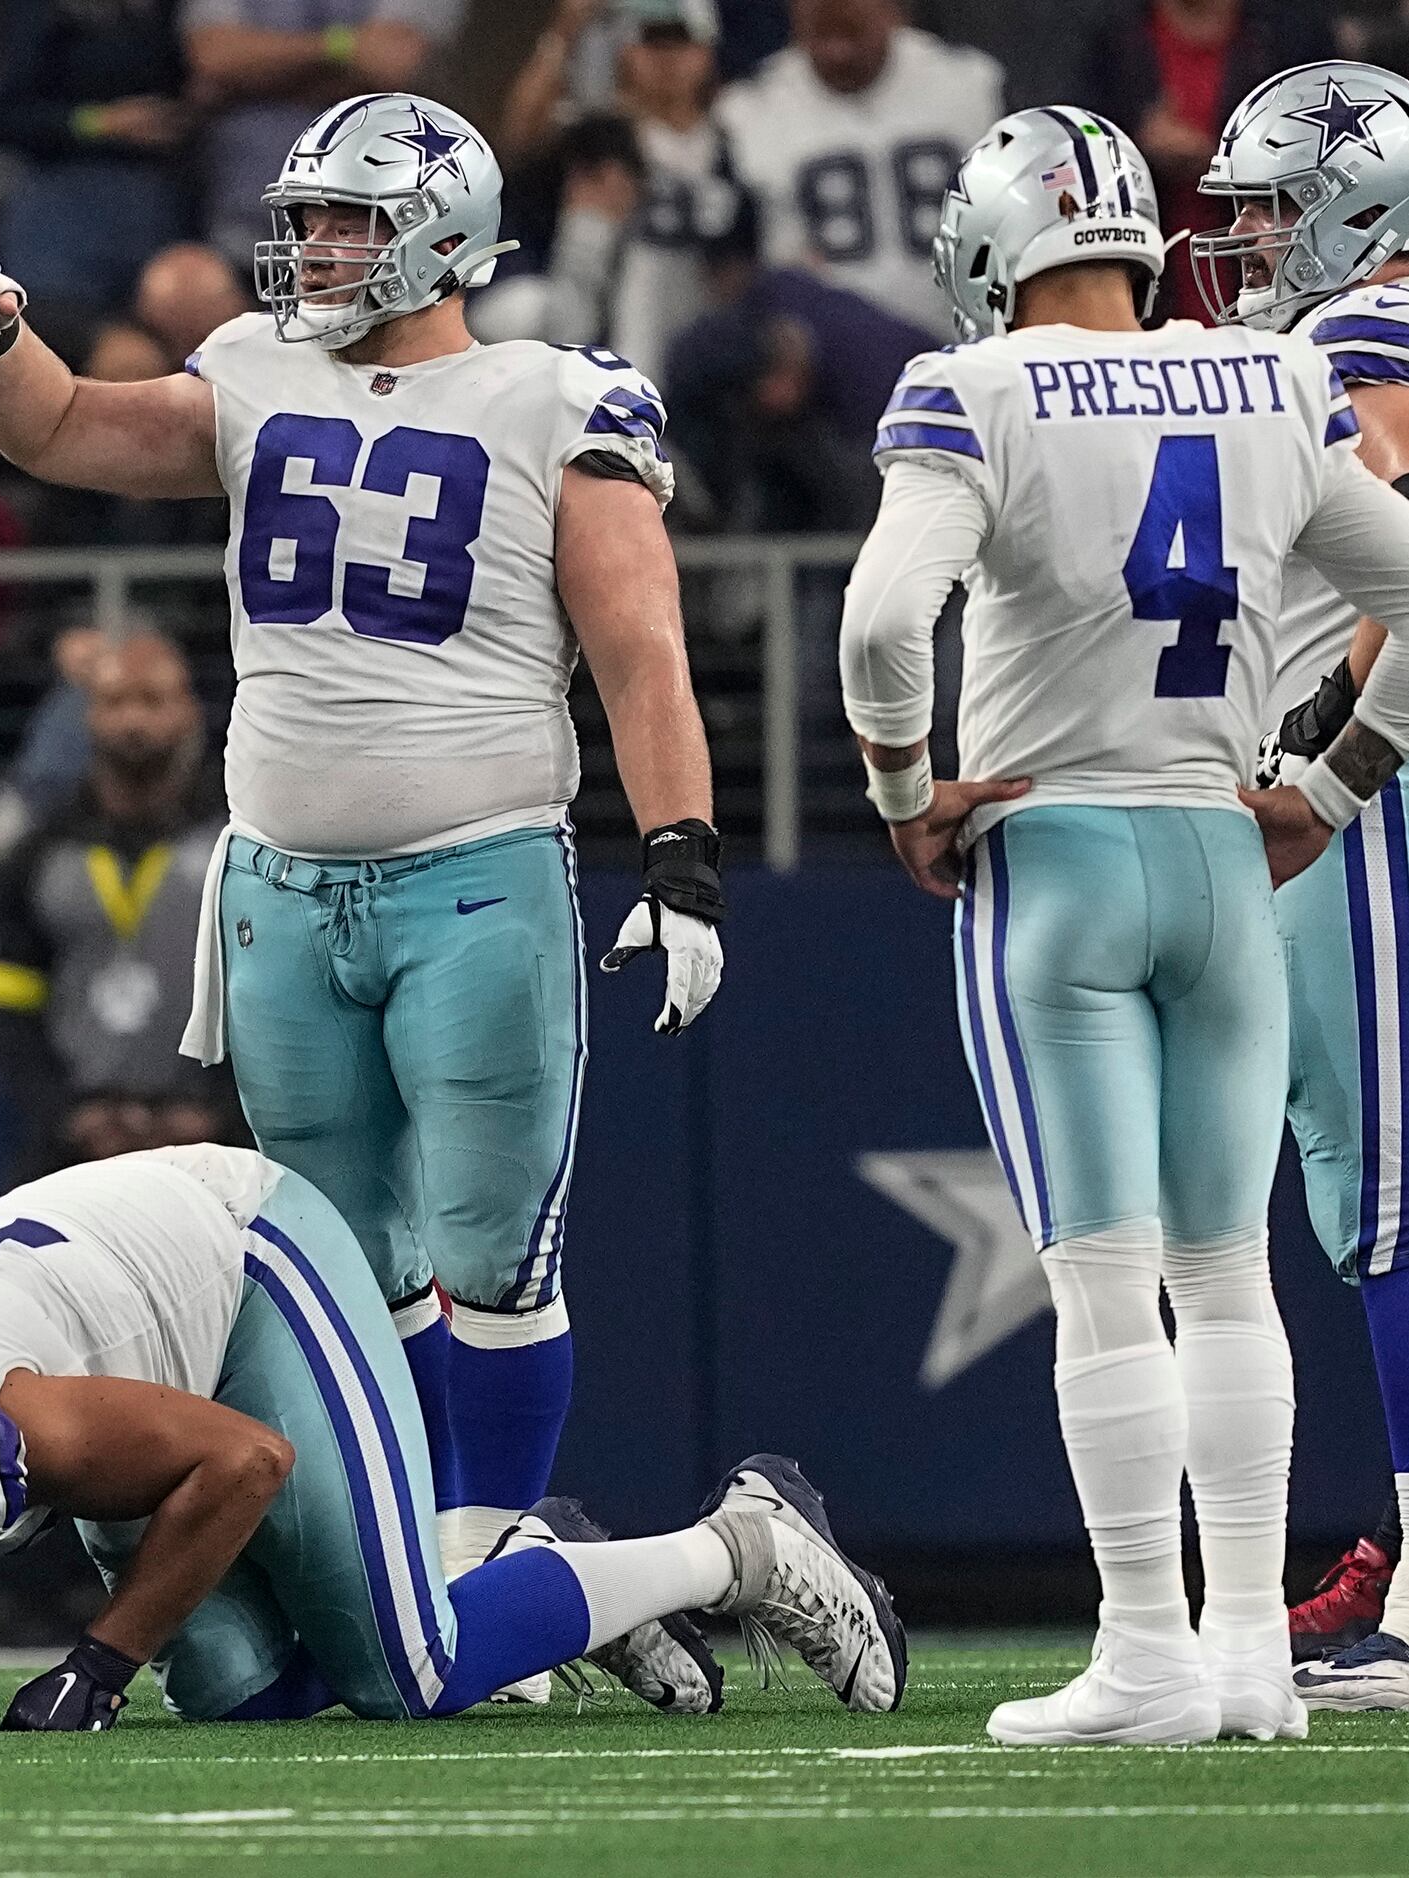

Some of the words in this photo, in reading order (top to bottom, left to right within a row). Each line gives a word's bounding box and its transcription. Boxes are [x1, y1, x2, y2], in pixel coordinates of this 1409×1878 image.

[1074, 228, 1146, 245] COWBOYS
[1024, 355, 1285, 420] PRESCOTT
[239, 412, 491, 646] 63
[1121, 434, 1240, 698] 4
